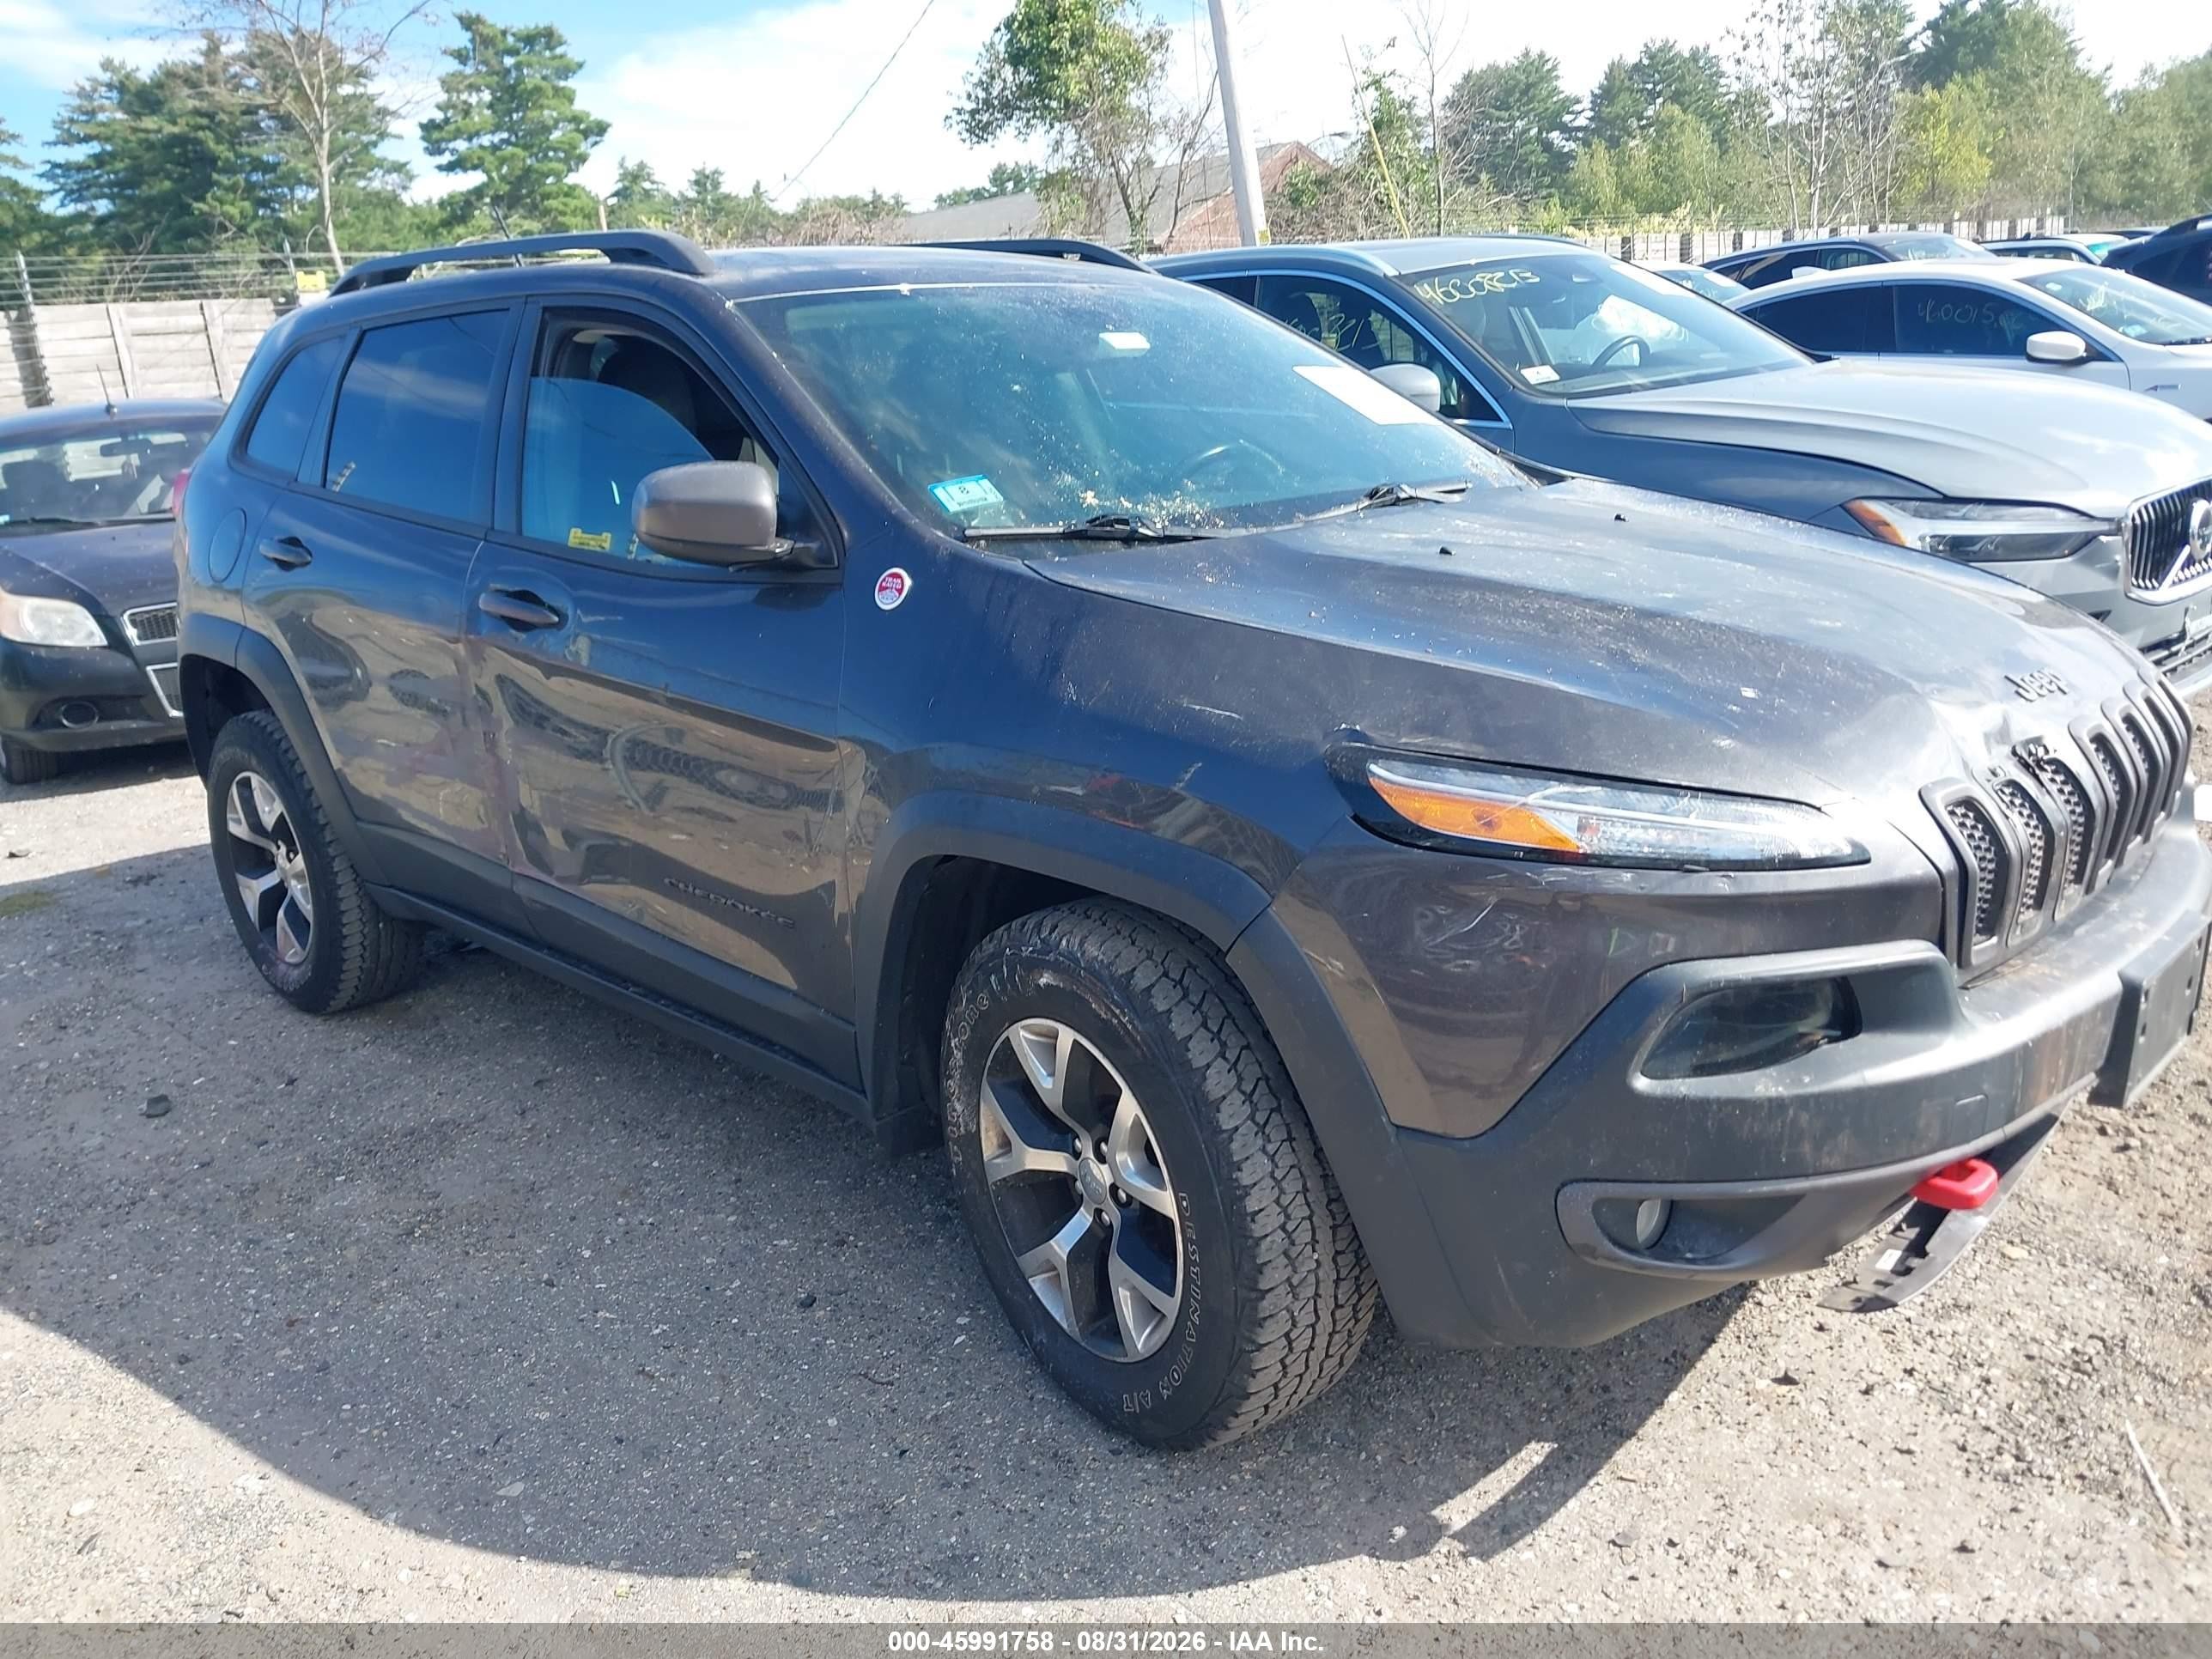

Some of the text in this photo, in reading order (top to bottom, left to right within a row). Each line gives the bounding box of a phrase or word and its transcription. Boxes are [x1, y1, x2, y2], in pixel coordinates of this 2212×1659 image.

[2003, 669, 2069, 702] Jeep
[1122, 1192, 1202, 1413] DESTINATION A/T
